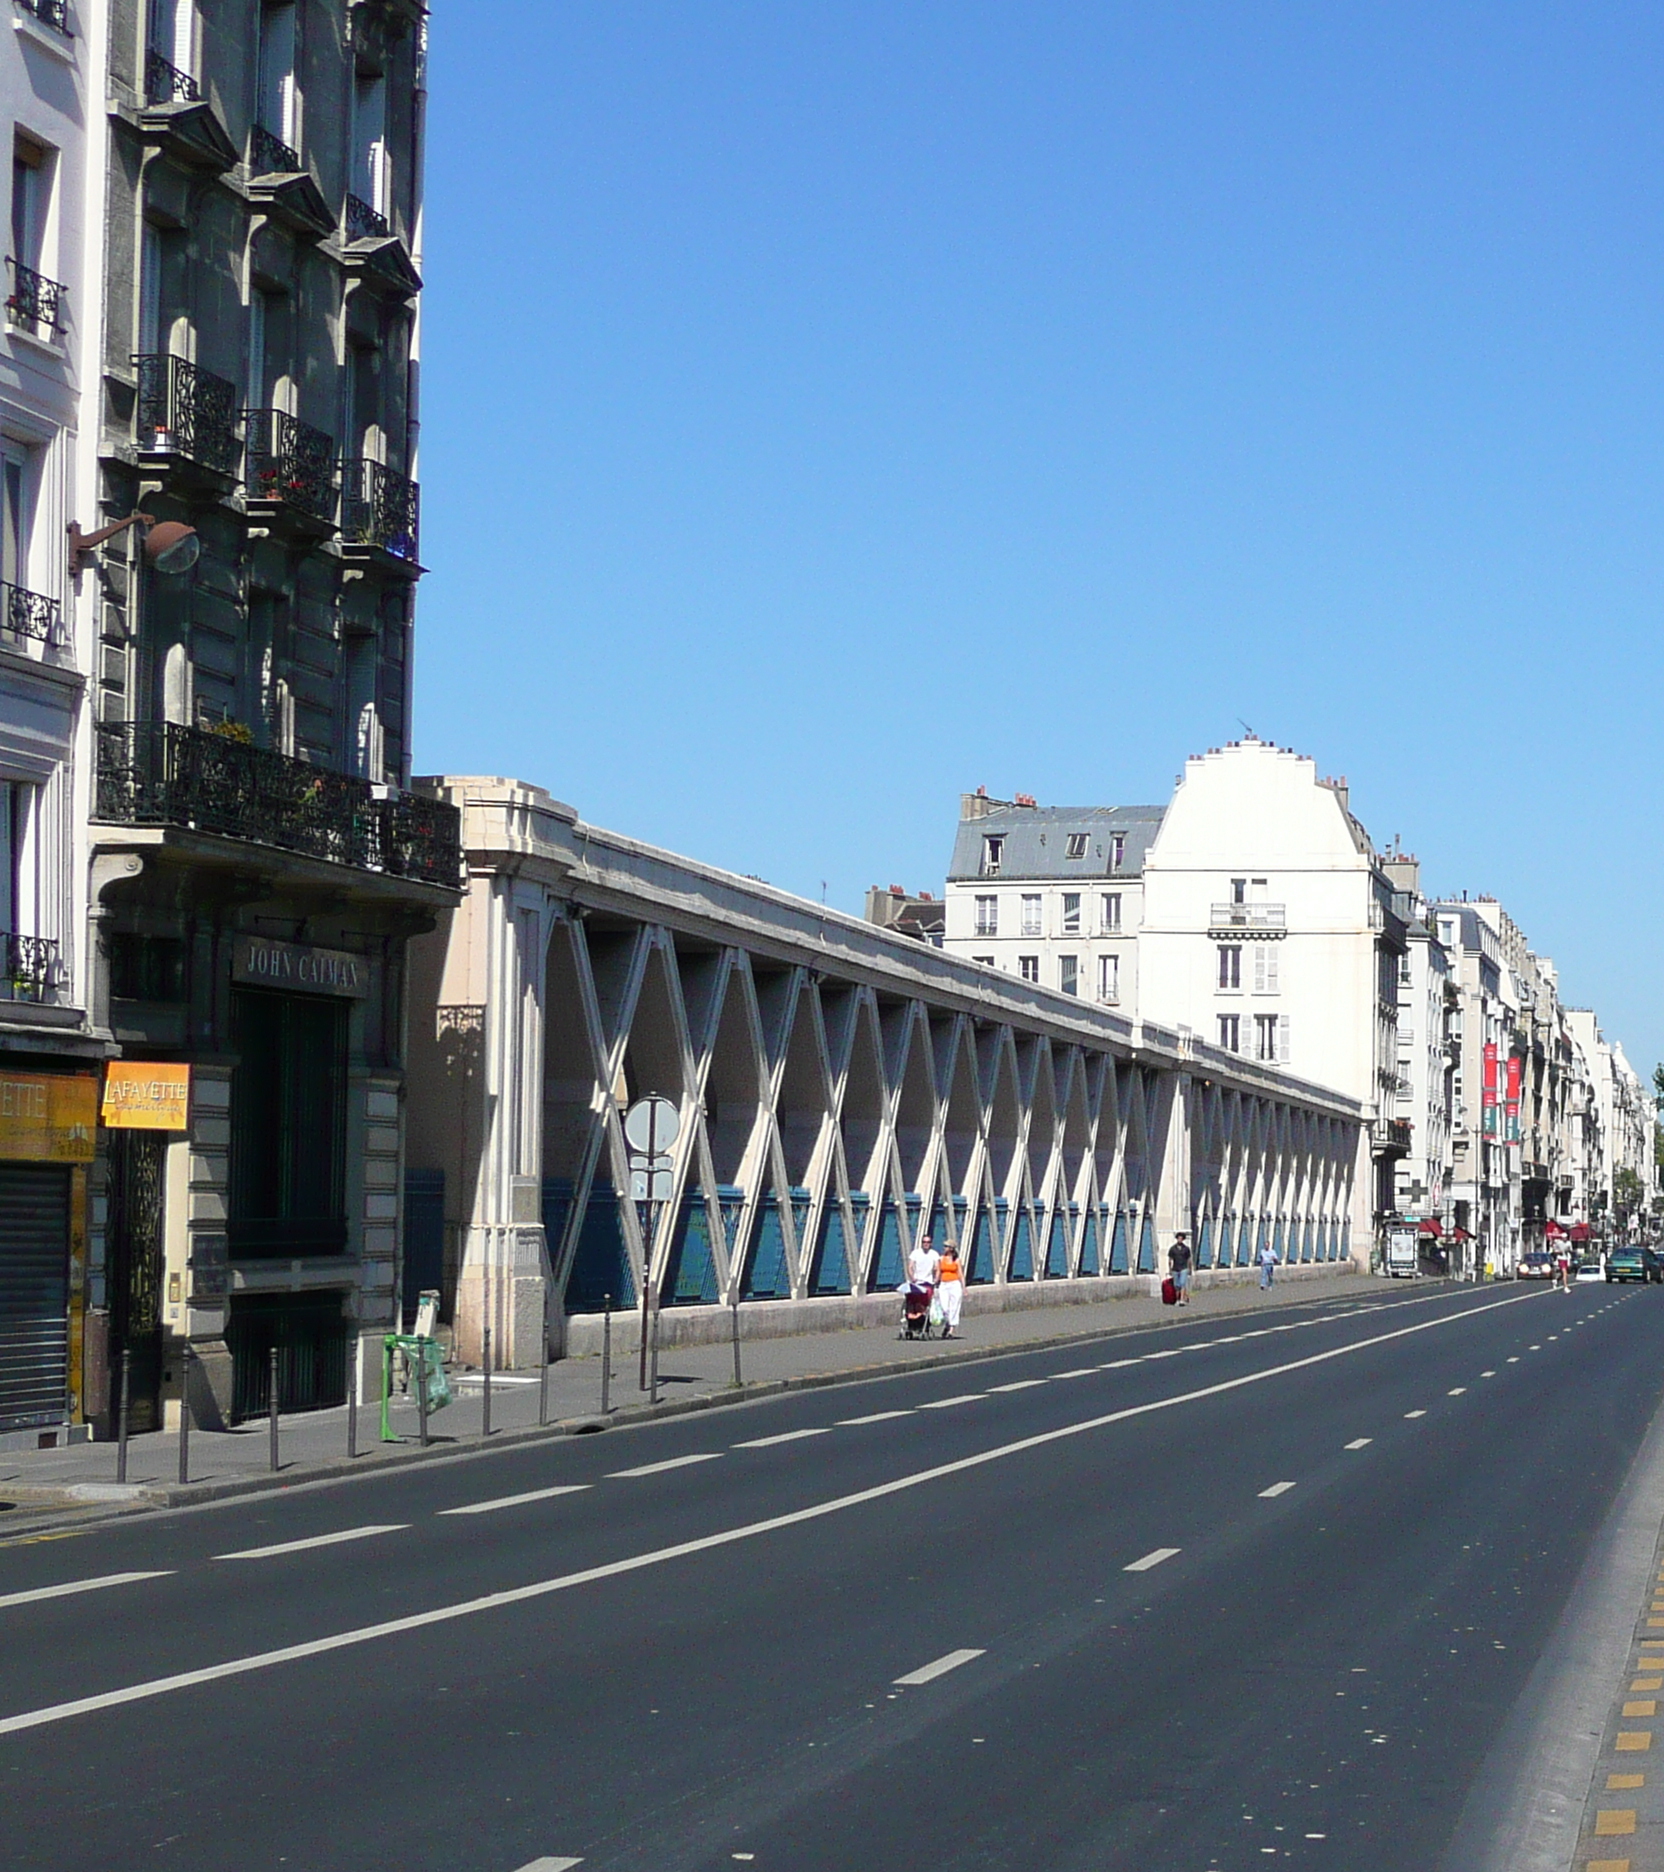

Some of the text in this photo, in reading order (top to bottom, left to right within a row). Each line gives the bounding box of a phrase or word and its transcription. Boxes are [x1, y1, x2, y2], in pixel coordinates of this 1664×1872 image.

[247, 945, 358, 987] JOHN CAIMAN
[0, 1080, 47, 1118] ETTE
[103, 1080, 187, 1104] LAFAYETTE
